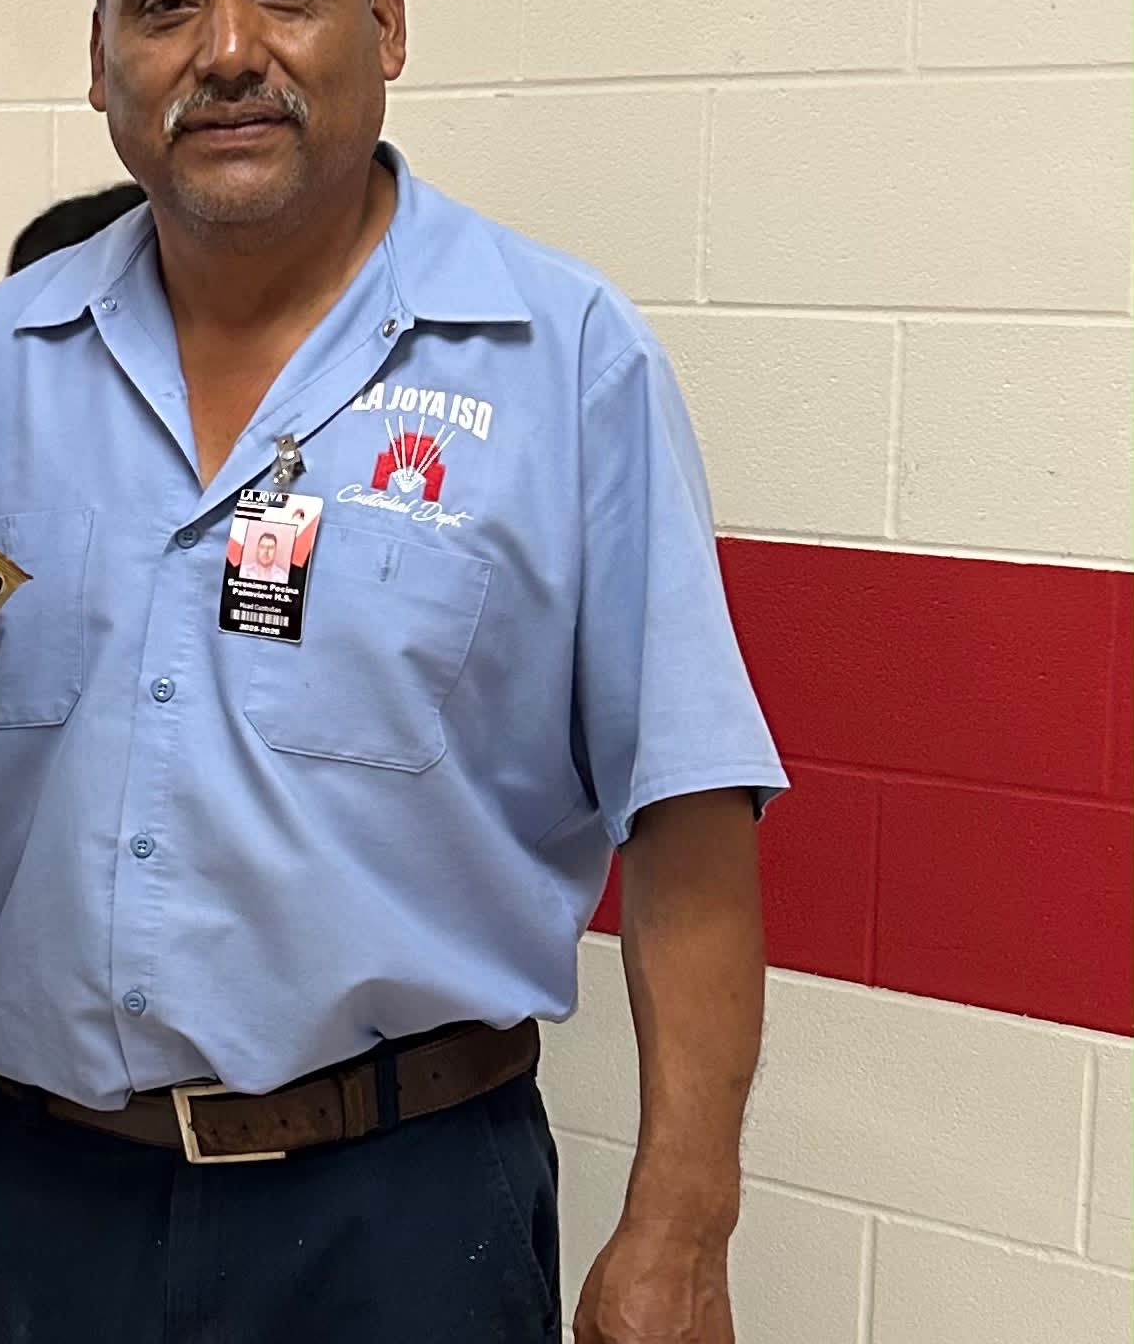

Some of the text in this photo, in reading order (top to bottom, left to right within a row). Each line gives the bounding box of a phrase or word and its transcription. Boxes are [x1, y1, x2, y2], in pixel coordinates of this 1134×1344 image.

[386, 385, 447, 420] JOYA
[449, 394, 493, 441] ISD
[240, 489, 284, 503] LA JOYA
[336, 483, 419, 513] Custodial
